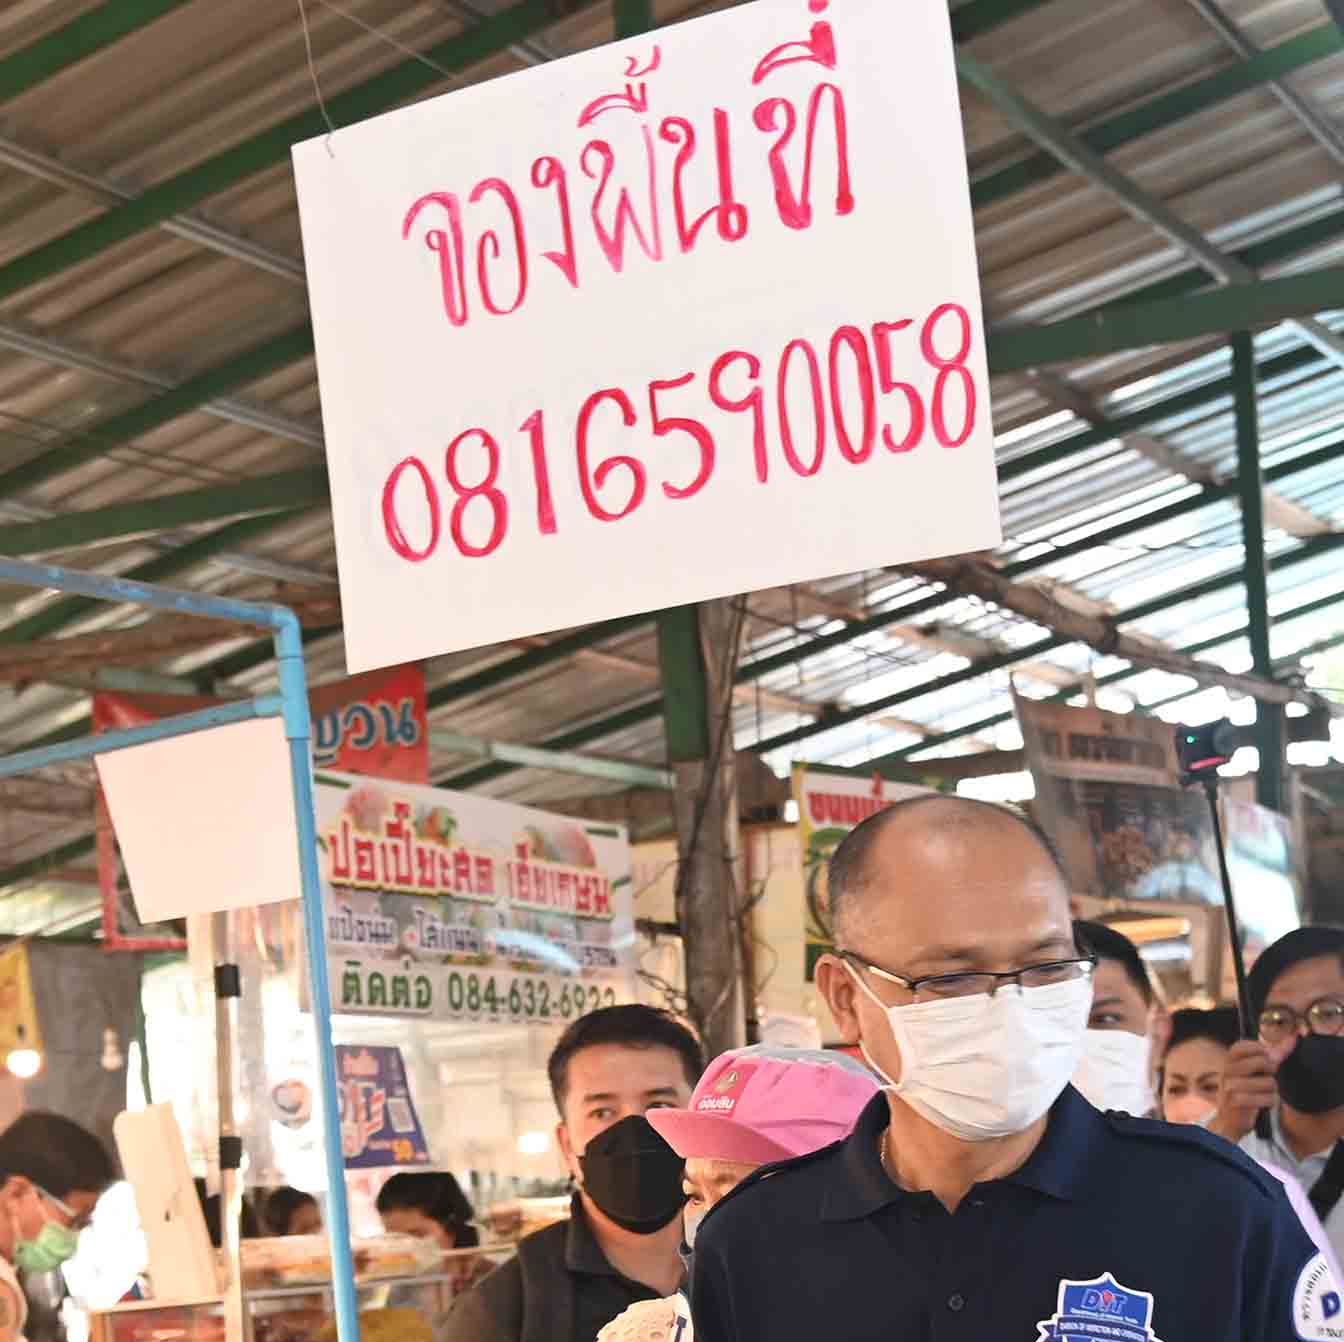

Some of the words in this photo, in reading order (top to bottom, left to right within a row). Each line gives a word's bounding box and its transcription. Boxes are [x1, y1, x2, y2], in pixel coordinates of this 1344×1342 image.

[381, 303, 977, 563] 0816590058
[341, 955, 433, 1009] ติดต่อ
